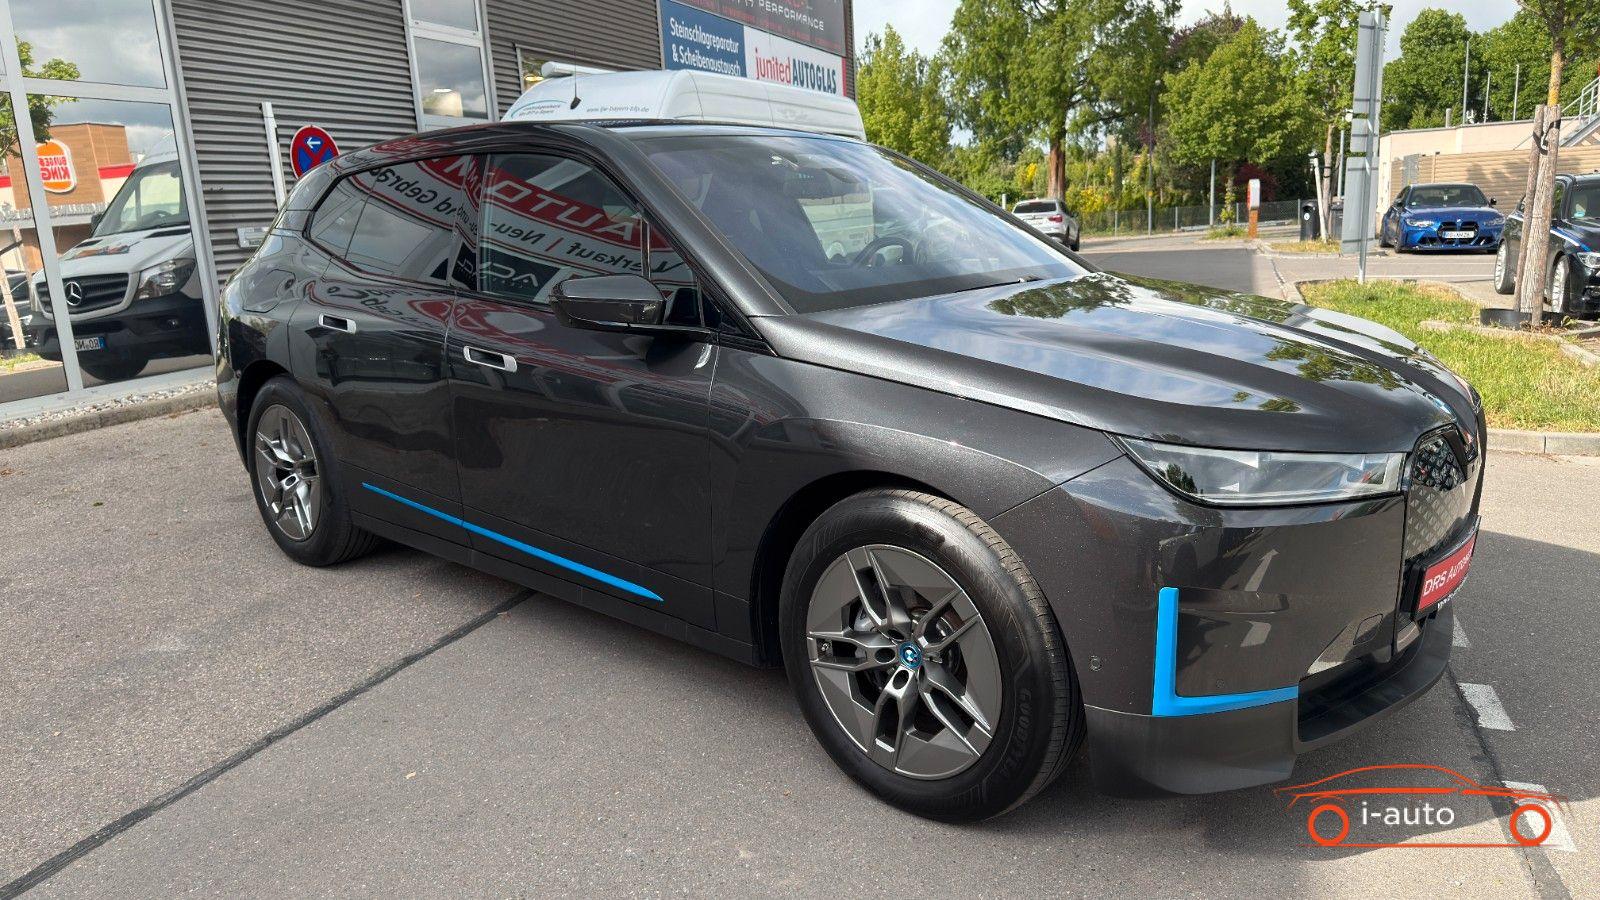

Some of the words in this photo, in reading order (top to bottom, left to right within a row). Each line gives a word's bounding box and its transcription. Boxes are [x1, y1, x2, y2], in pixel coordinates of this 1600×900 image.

[758, 0, 825, 31] PERFORMANCE
[669, 17, 740, 54] Steinschlagreparatur
[671, 43, 679, 61] &
[679, 47, 742, 76] Scheibenaustausch
[755, 47, 792, 84] junited
[792, 58, 837, 95] AUTOGLAS
[1423, 570, 1448, 597] DRS
